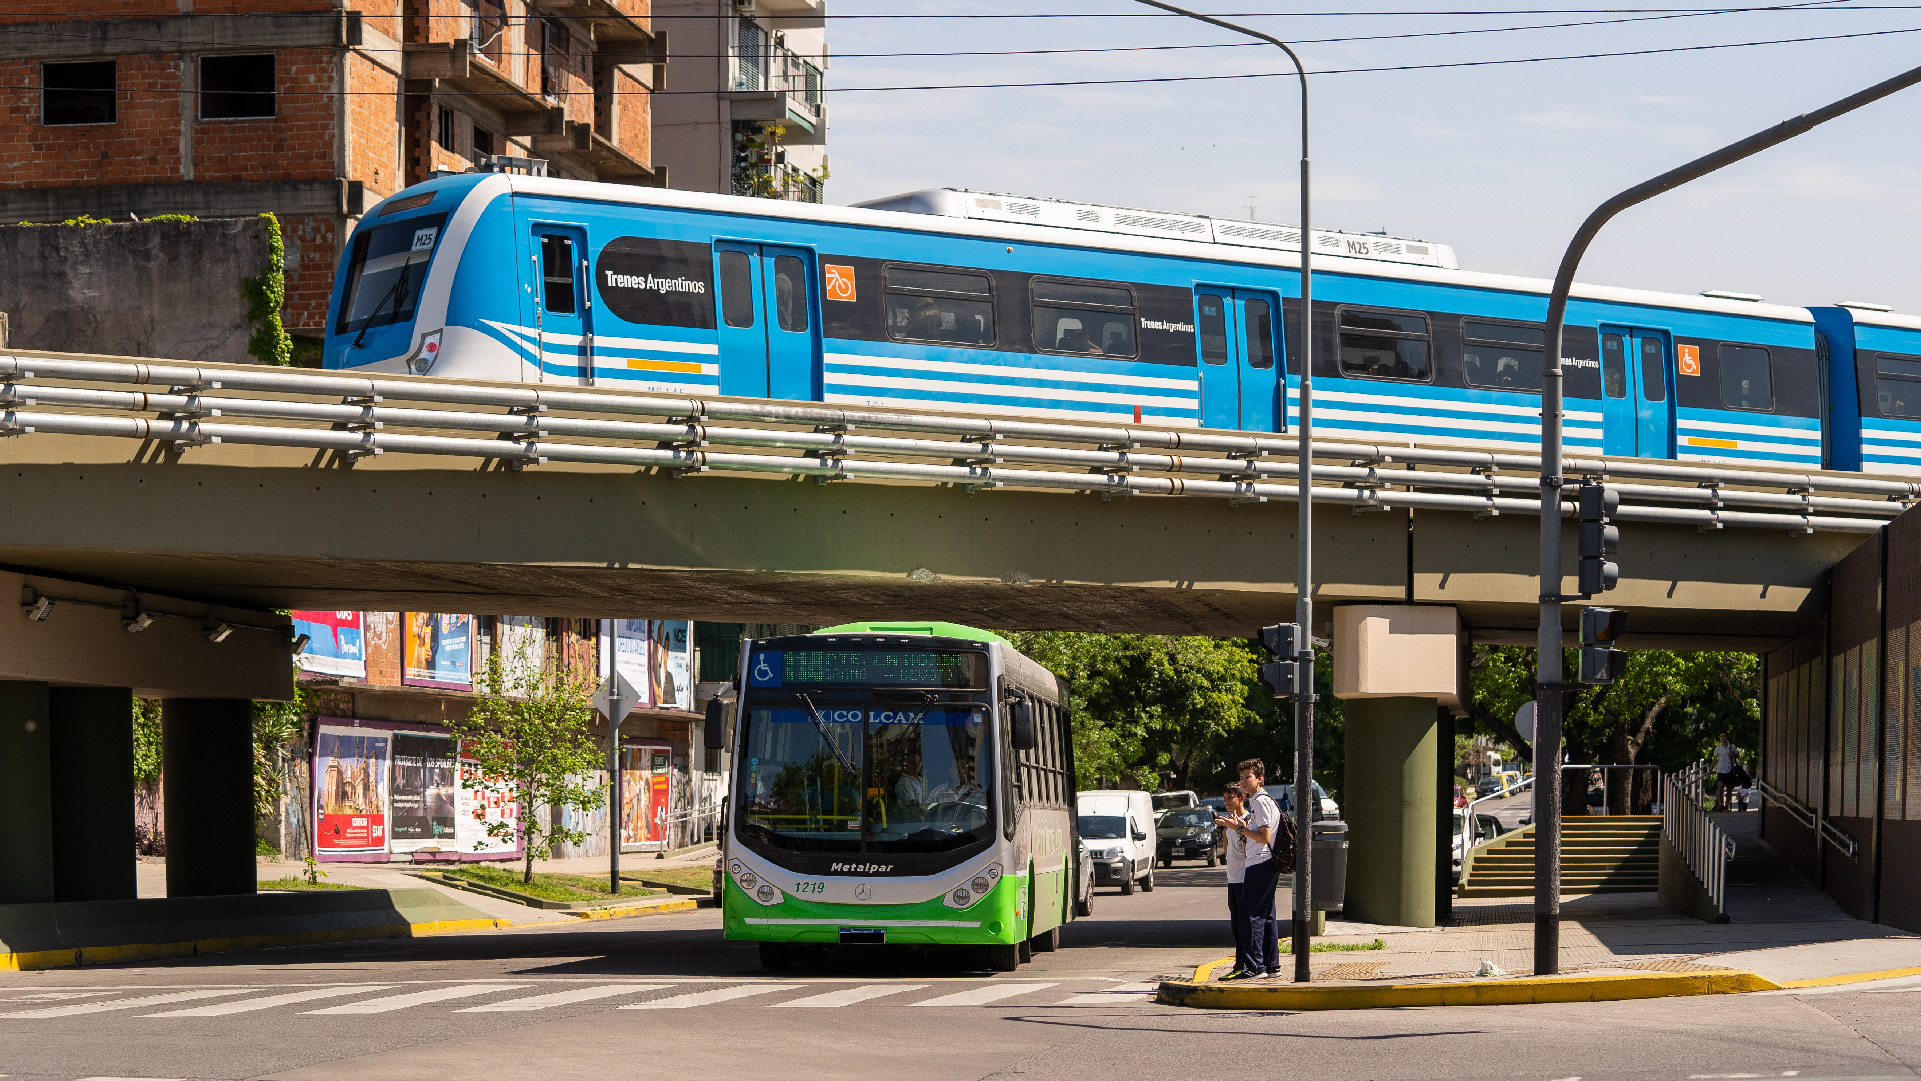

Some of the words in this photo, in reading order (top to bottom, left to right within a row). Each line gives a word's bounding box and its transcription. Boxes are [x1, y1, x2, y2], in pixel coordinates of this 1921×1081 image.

[415, 233, 434, 247] M25
[1346, 239, 1370, 255] M25
[605, 270, 646, 289] Trenes
[646, 273, 705, 294] Argentinos
[1140, 317, 1163, 330] Trenes
[1162, 319, 1195, 333] Argentinos
[1572, 356, 1600, 369] Argentinos
[830, 862, 894, 874] Metalpar
[795, 881, 825, 894] 1219
